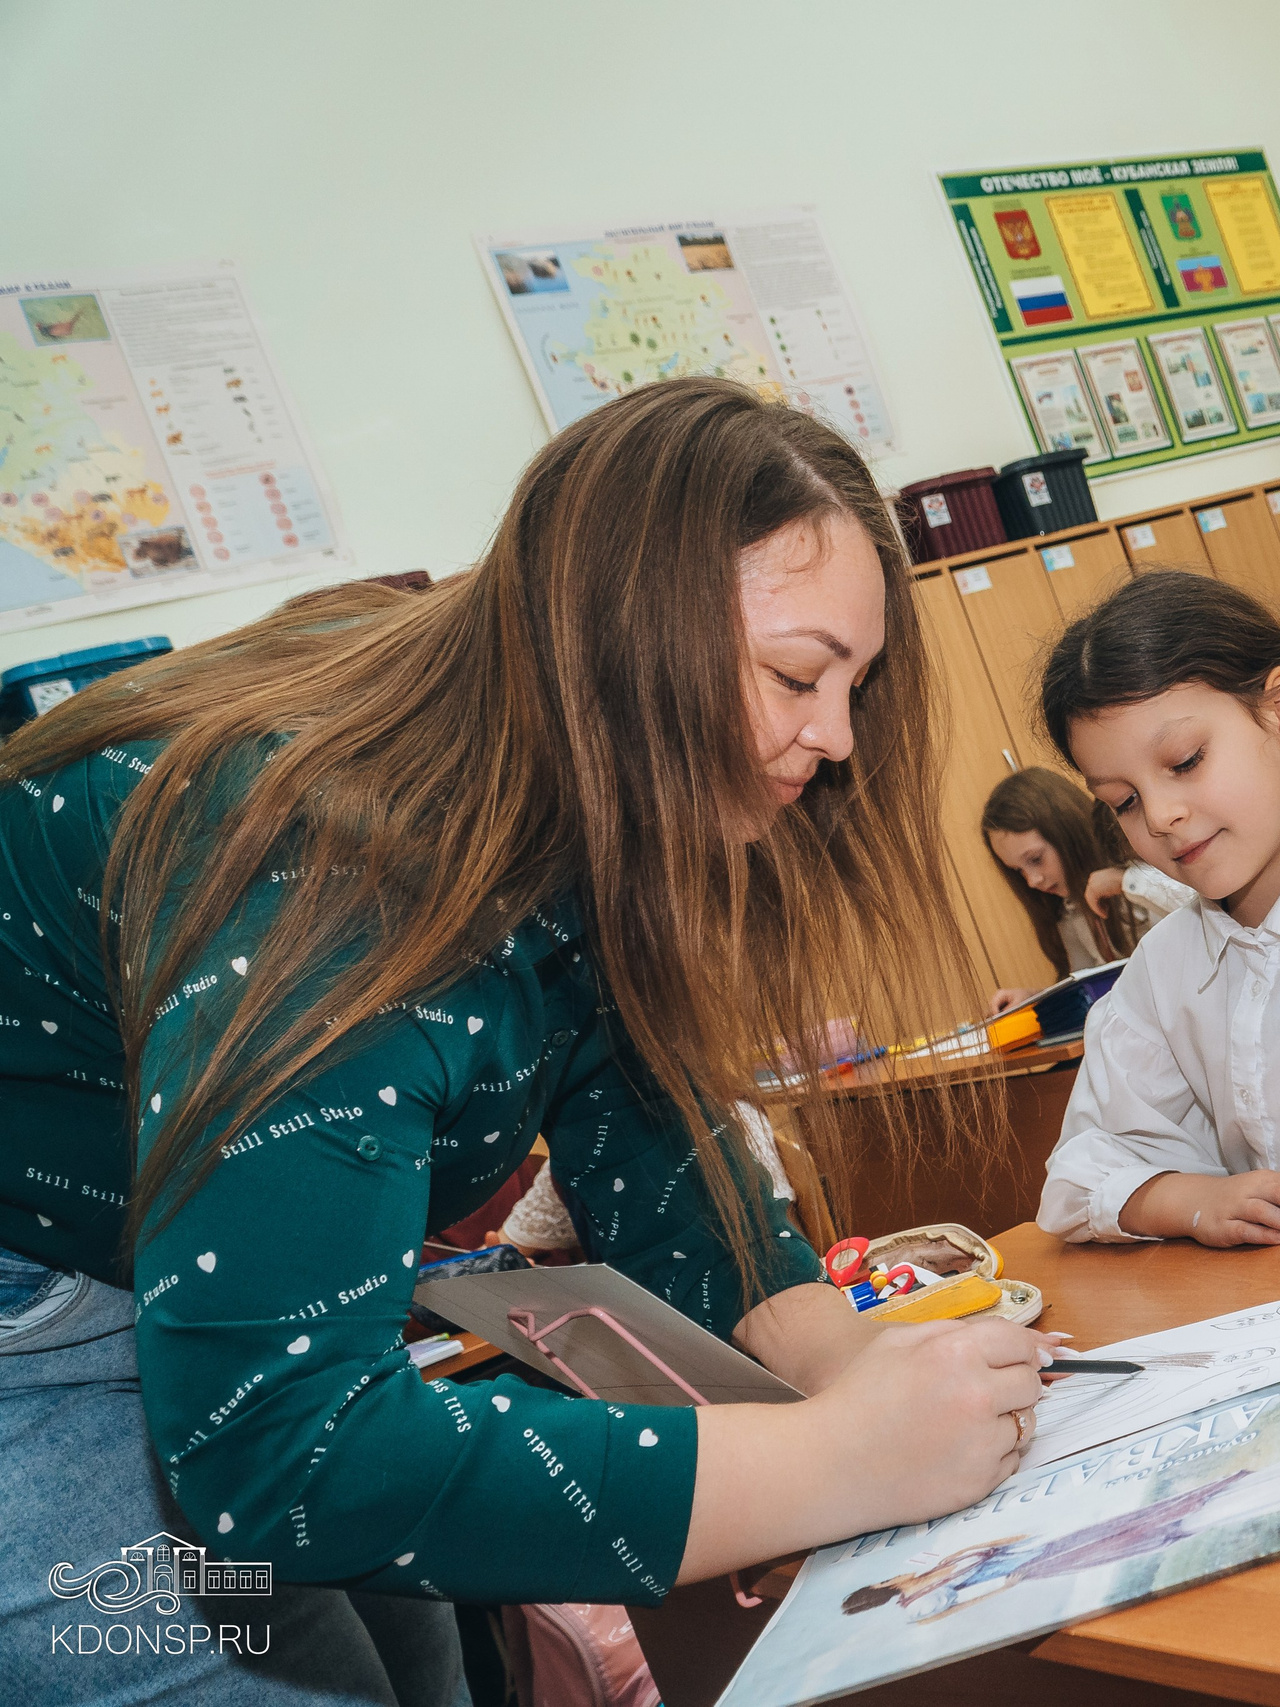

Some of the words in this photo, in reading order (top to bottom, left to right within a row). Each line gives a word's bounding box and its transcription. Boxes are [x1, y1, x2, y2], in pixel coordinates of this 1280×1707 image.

[980, 169, 1070, 193] ОТЕЧЕСТВО
[1070, 165, 1104, 187] МОЁ
[1111, 159, 1191, 181] КУБАНСКАЯ
[101, 744, 125, 765] Still
[128, 756, 152, 775] Stud
[77, 887, 101, 911] Still
[155, 994, 180, 1020] Still
[182, 974, 218, 998] Studio
[415, 1006, 454, 1025] Studio
[99, 1077, 126, 1090] Sti
[472, 1080, 512, 1093] Still
[220, 1131, 264, 1159] Still
[269, 1112, 316, 1139] Still
[319, 1106, 363, 1123] Stio
[26, 1167, 70, 1190] Still
[81, 1184, 125, 1206] Still
[657, 1179, 677, 1214] Still
[143, 1274, 179, 1307] Studio
[337, 1272, 389, 1305] Studio
[209, 1373, 264, 1425] Studio
[444, 1395, 472, 1433] Still
[523, 1428, 564, 1478] Studio
[1156, 1429, 1260, 1474] бумага
[562, 1479, 597, 1524] Still
[288, 1504, 310, 1548] Still
[611, 1536, 644, 1573] Still
